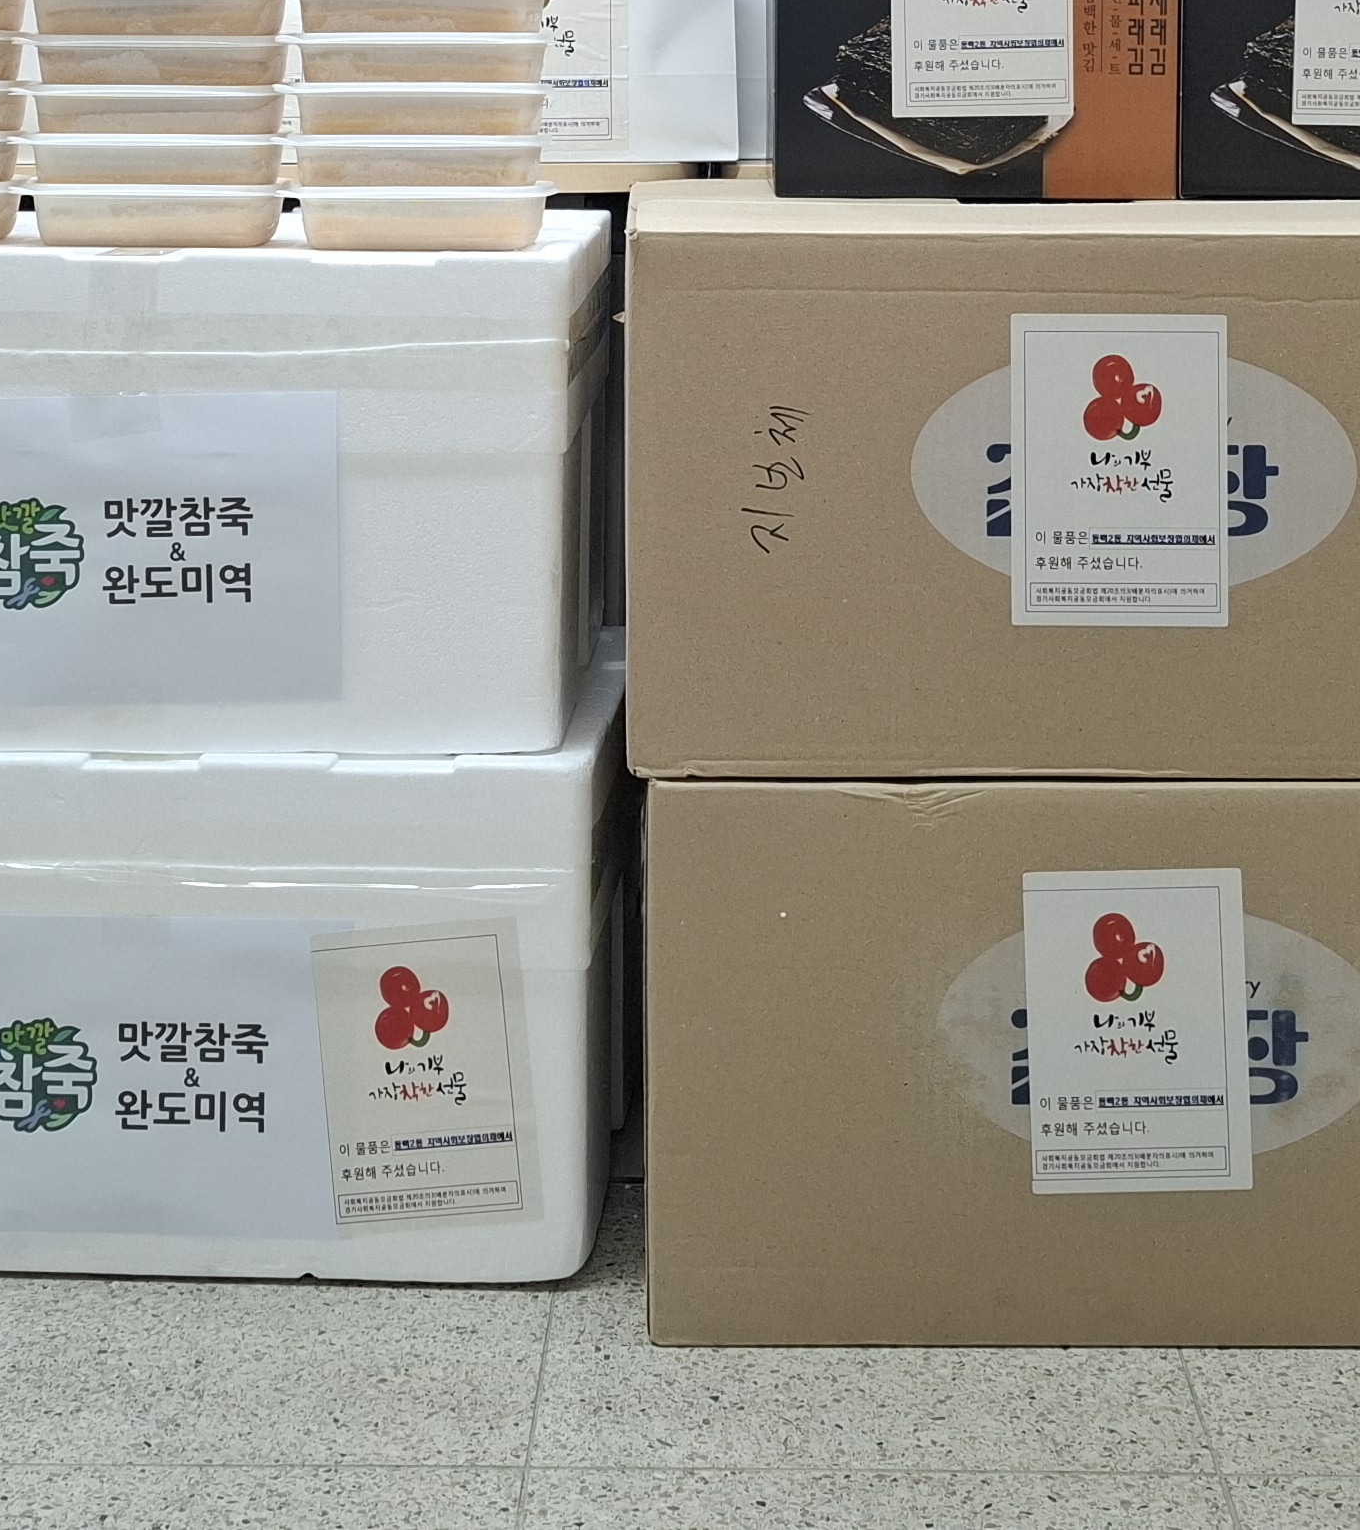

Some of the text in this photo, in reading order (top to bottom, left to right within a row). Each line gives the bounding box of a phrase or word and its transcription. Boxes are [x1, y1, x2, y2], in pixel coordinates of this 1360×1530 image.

[914, 58, 1004, 72] 후원해 주셨습니다.
[1302, 68, 1333, 80] 후원해
[103, 496, 253, 540] 맛깔참죽
[170, 541, 187, 562] &
[1036, 556, 1142, 570] 후원해 주셨습니다.
[101, 563, 253, 605] 완도미역
[0, 1019, 55, 1051] 맛깔
[117, 1022, 270, 1064] 맛깔참죽
[184, 1067, 200, 1088] &
[115, 1090, 267, 1133] 완도미역
[1040, 1097, 1051, 1111] 이
[1057, 1096, 1095, 1111] 물품은
[1041, 1119, 1150, 1137] 후원해 주셨습니다.
[341, 1159, 445, 1182] 후원해 주셨습니다.
